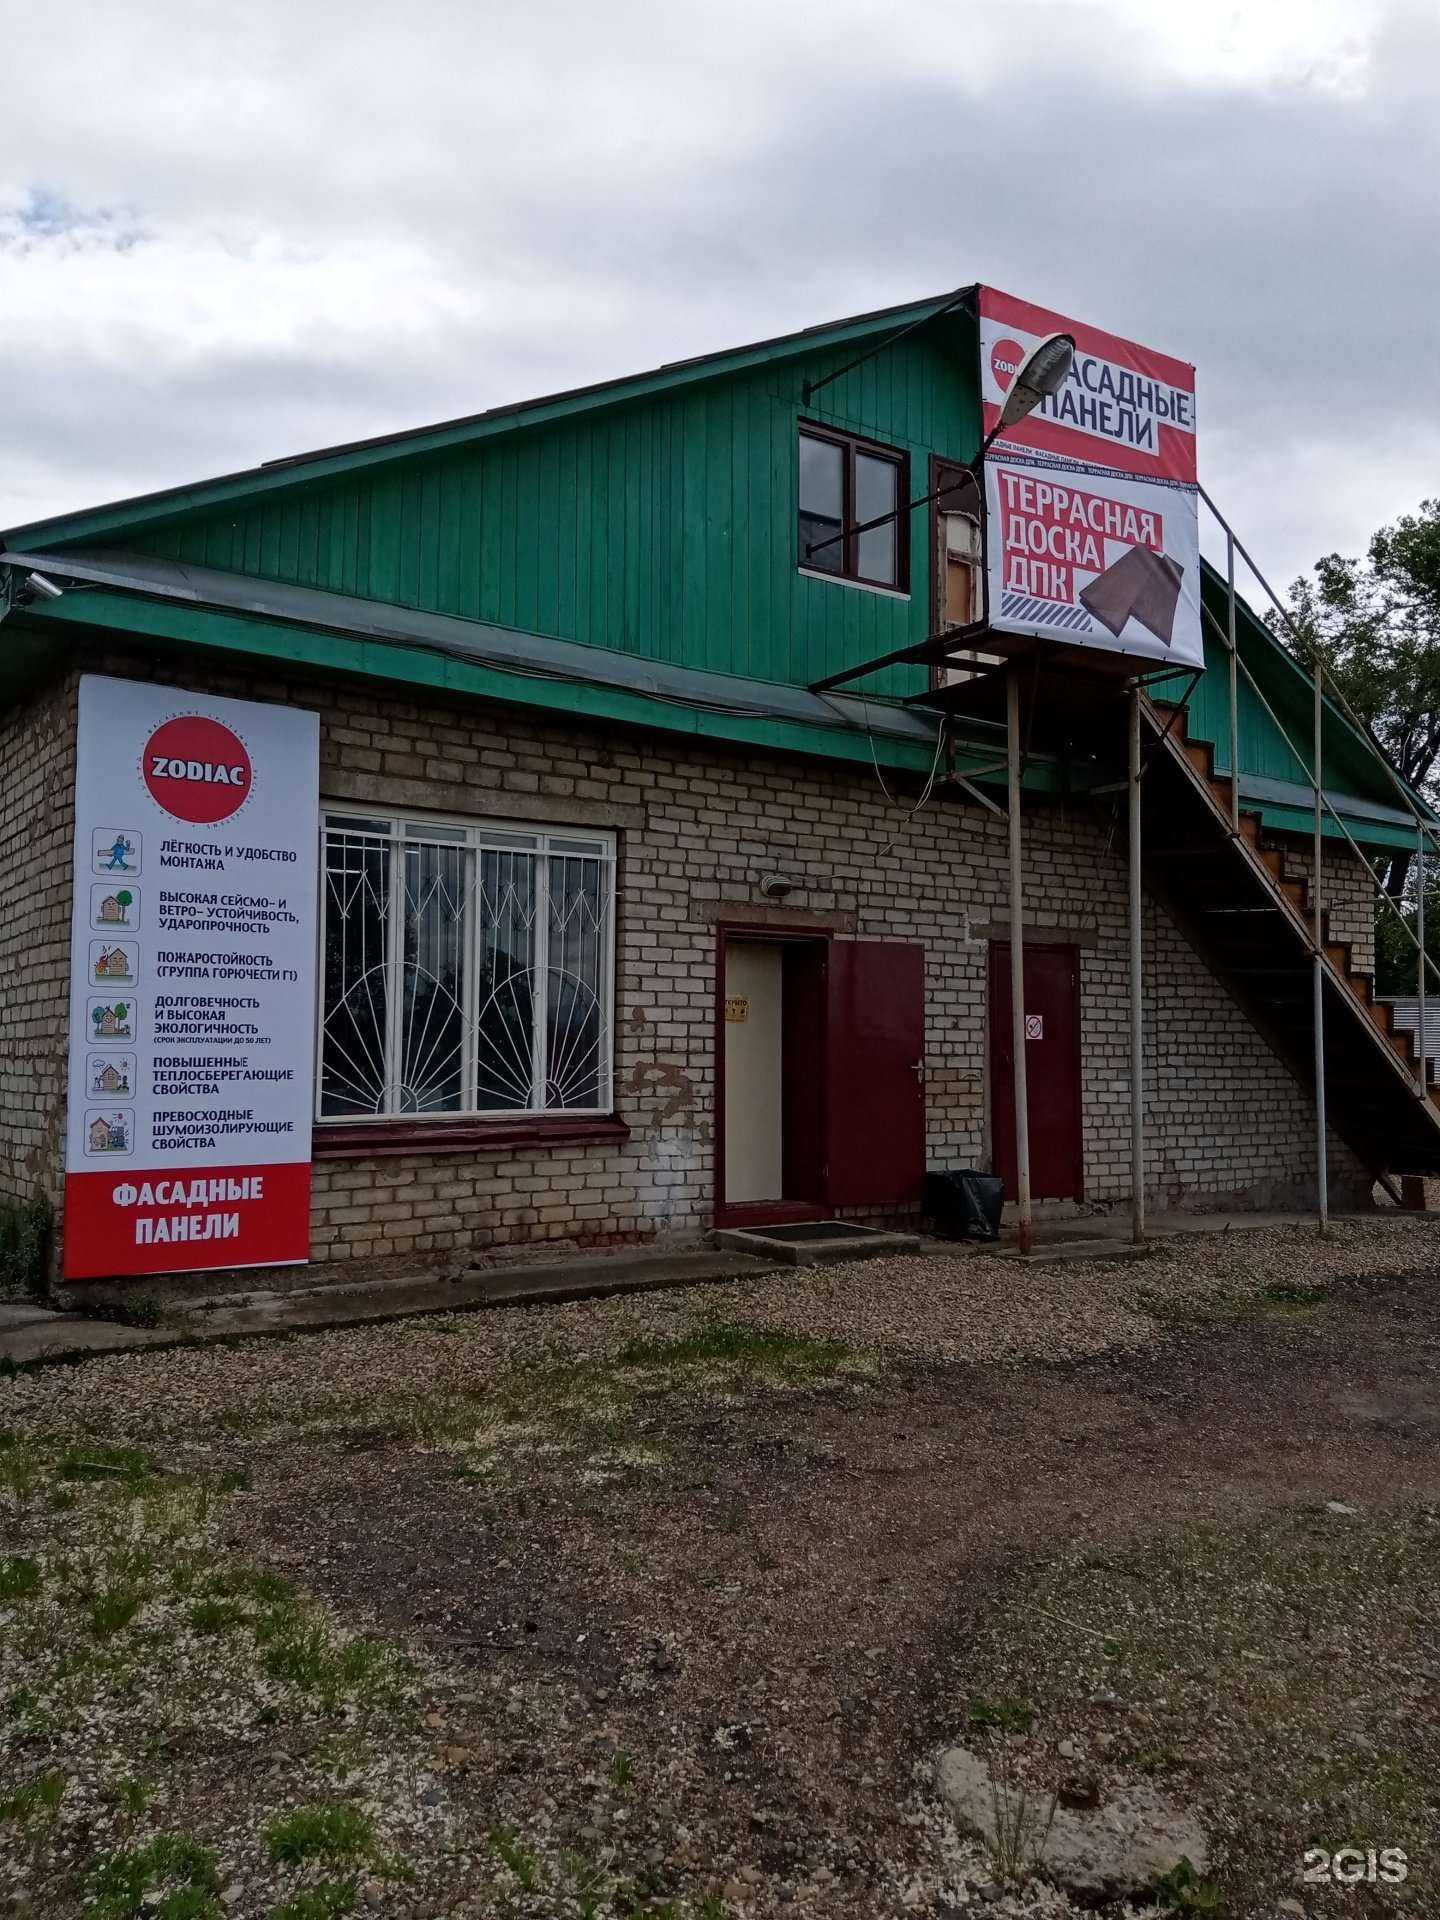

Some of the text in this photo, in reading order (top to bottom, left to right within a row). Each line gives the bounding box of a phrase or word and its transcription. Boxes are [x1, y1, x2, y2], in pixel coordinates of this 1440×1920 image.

[994, 359, 1016, 374] ZOD
[1065, 356, 1191, 426] АСАДНЫЕ
[1040, 388, 1152, 449] ПАНЕЛИ
[1002, 474, 1156, 546] ТЕРРАСНАЯ
[1006, 515, 1101, 568] ДОСКА
[1007, 557, 1067, 601] ДПК
[151, 757, 245, 786] ZODIAC
[160, 840, 297, 862] ЛЁГКОСТЬ И УДОБСТВО
[160, 856, 225, 870] МОНТАЖА
[160, 892, 286, 908] ВЫСОКАЯ СЕЙСМО- И
[160, 906, 299, 924] ВЕТРО- УСТОЙЧИВОСТЬ,
[158, 918, 270, 934] УДАРОПРОЧНОСТЬ
[157, 951, 273, 967] ПОЖАРОСТОЙКОСТЬ
[157, 965, 210, 979] (ГРУППА
[213, 967, 280, 981] ГОРЮЧЕСТИ
[155, 996, 260, 1009] ДОЛГОВЕЧНОСТЬ
[155, 1010, 226, 1021] И ВЫСОКАЯ
[154, 1023, 258, 1035] ЭКОЛОГИЧНОСТЬ
[153, 1057, 248, 1068] ПОВЫШЕННЫЕ
[153, 1070, 294, 1082] ТЕПЛОСБЕРЕГАЮЩИЕ
[152, 1083, 219, 1095] СВОЙСТВА
[153, 1110, 253, 1122] ПРЕВОСХОДНЫЕ
[152, 1122, 294, 1136] ШУМОИЗОЛИРУЮЩИЕ
[152, 1137, 216, 1149] СВОЙСТВА
[112, 1177, 263, 1208] ФАСАДНЫЕ
[135, 1213, 240, 1244] ПАНЕЛИ
